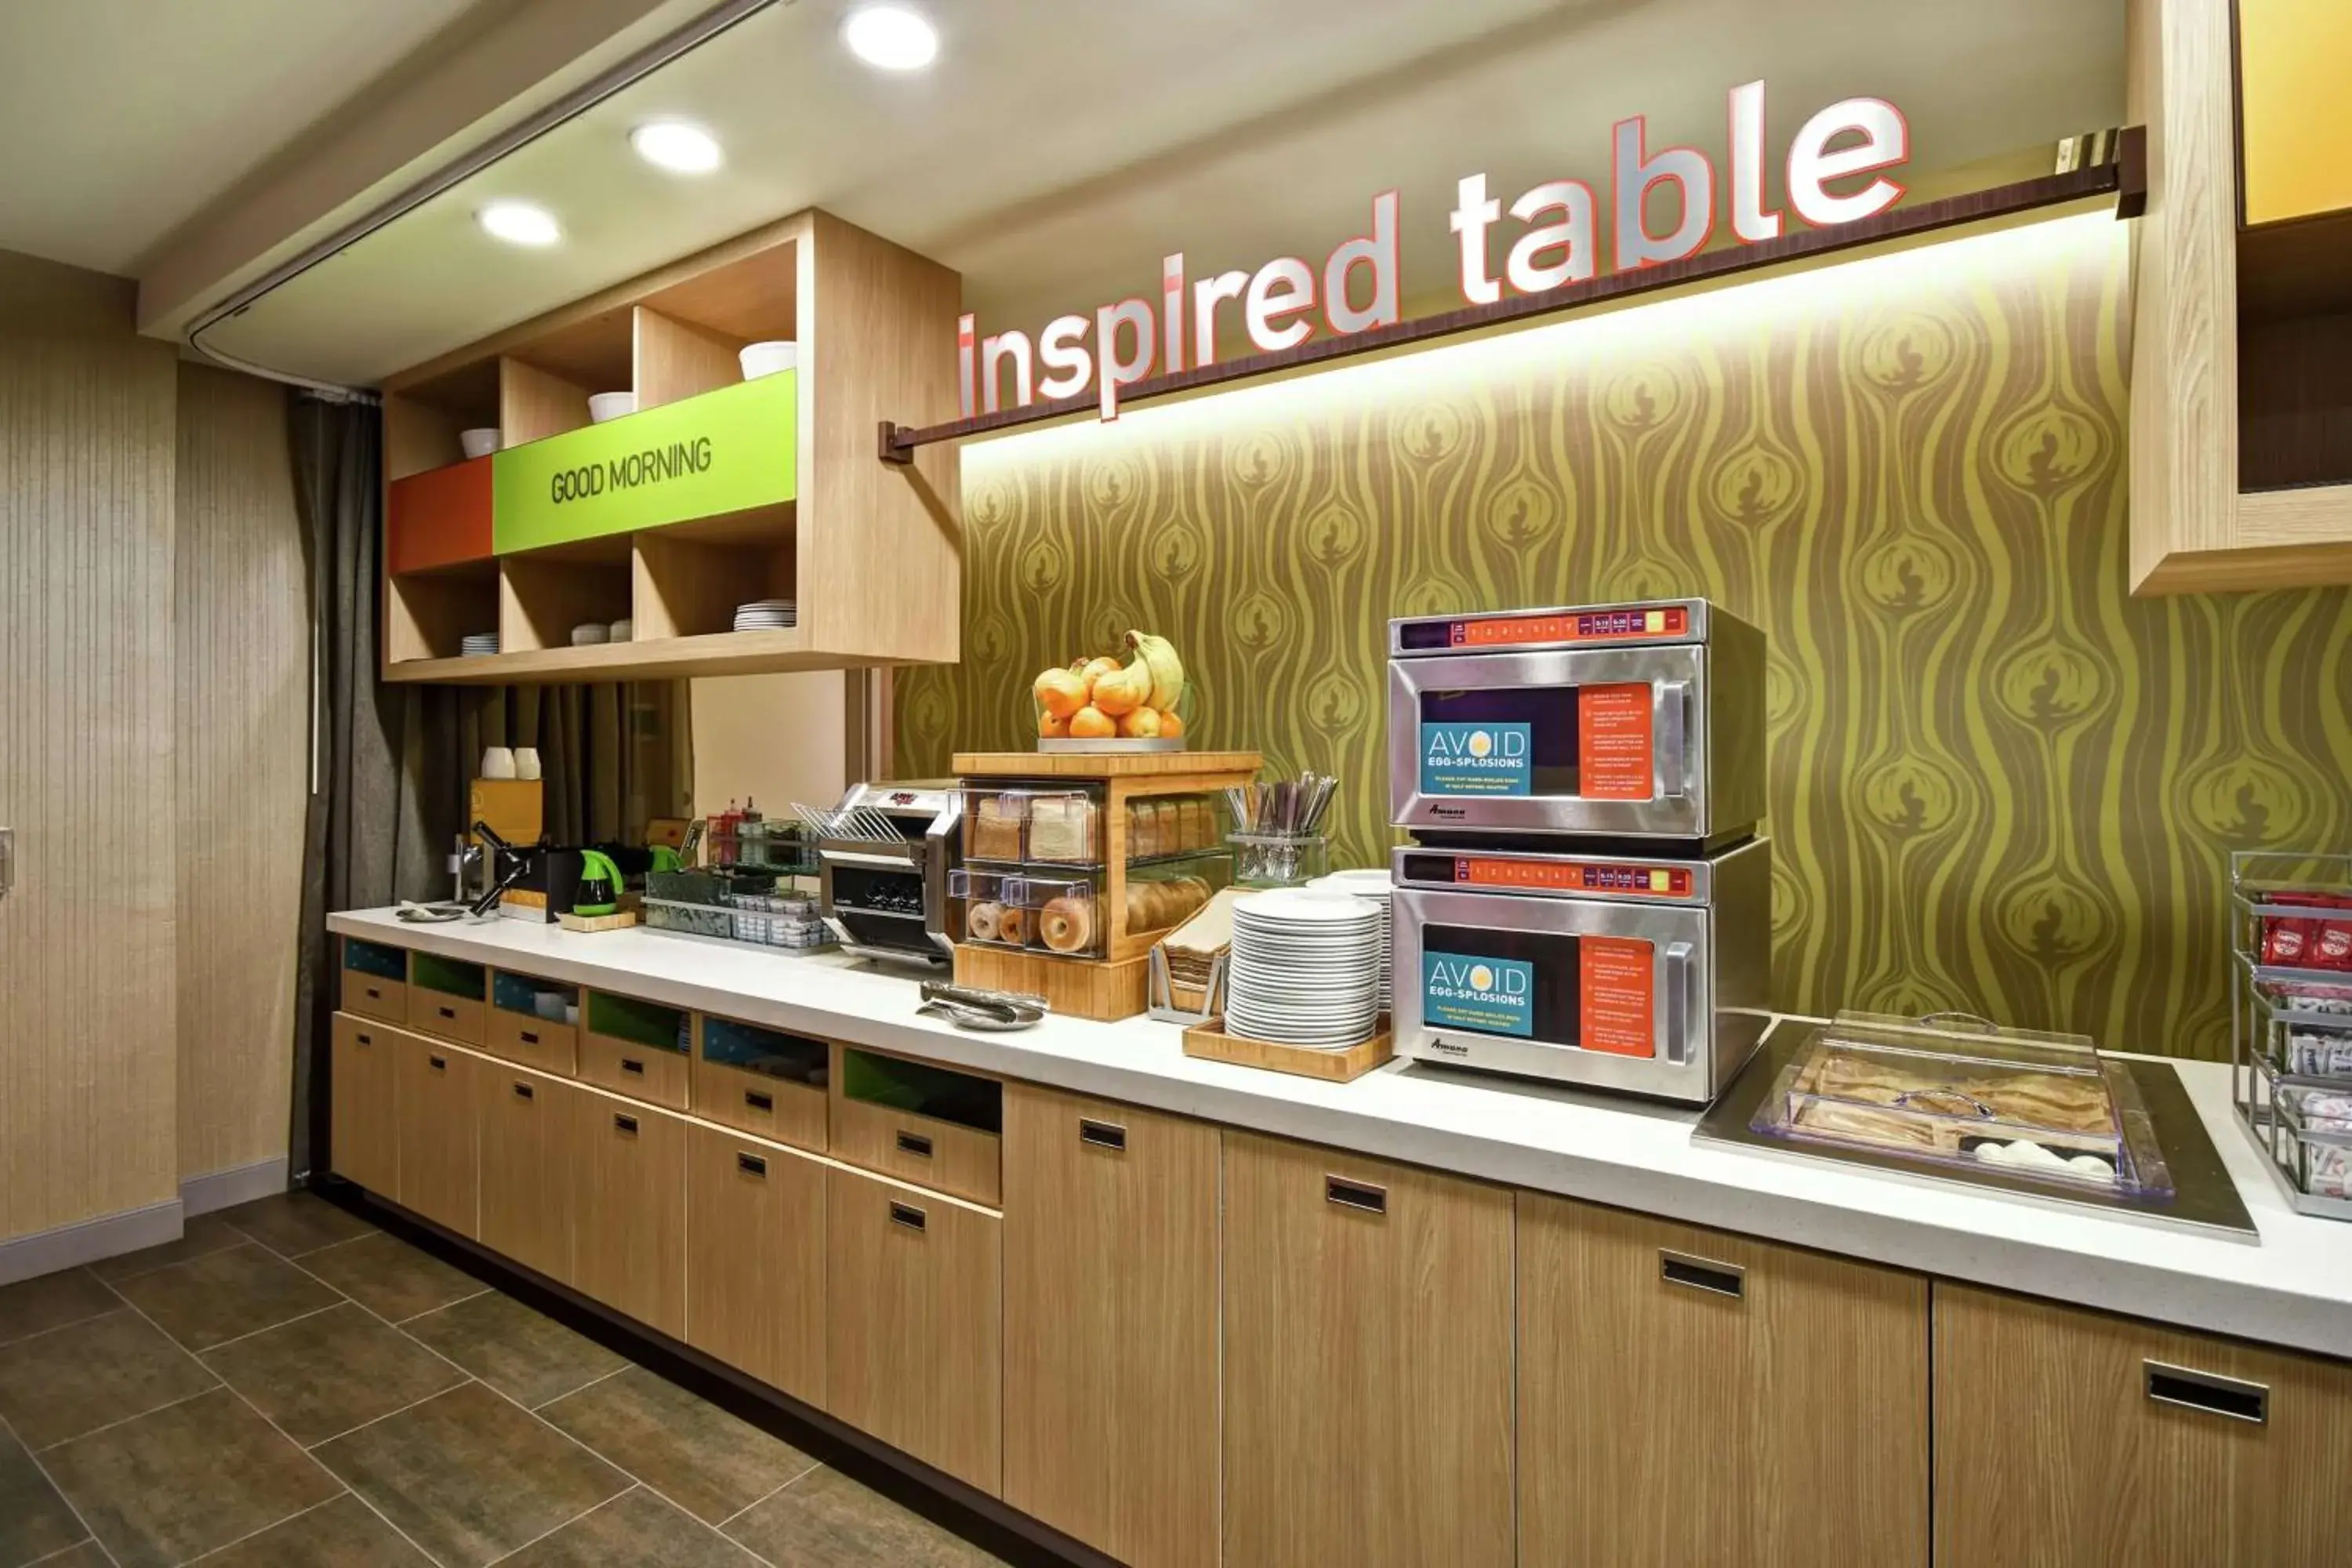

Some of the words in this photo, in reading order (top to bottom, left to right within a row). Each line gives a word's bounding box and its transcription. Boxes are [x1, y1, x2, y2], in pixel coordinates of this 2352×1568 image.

[958, 189, 1400, 423] inspired
[1450, 79, 1908, 306] table
[551, 463, 604, 504] GOOD
[609, 436, 712, 493] MORNING
[1428, 730, 1525, 757] AVOID
[1428, 757, 1524, 768] EGG-SPLOSIONS
[1429, 960, 1526, 995] AVOID
[1429, 985, 1526, 1007] EGG-SPLOSIONS
